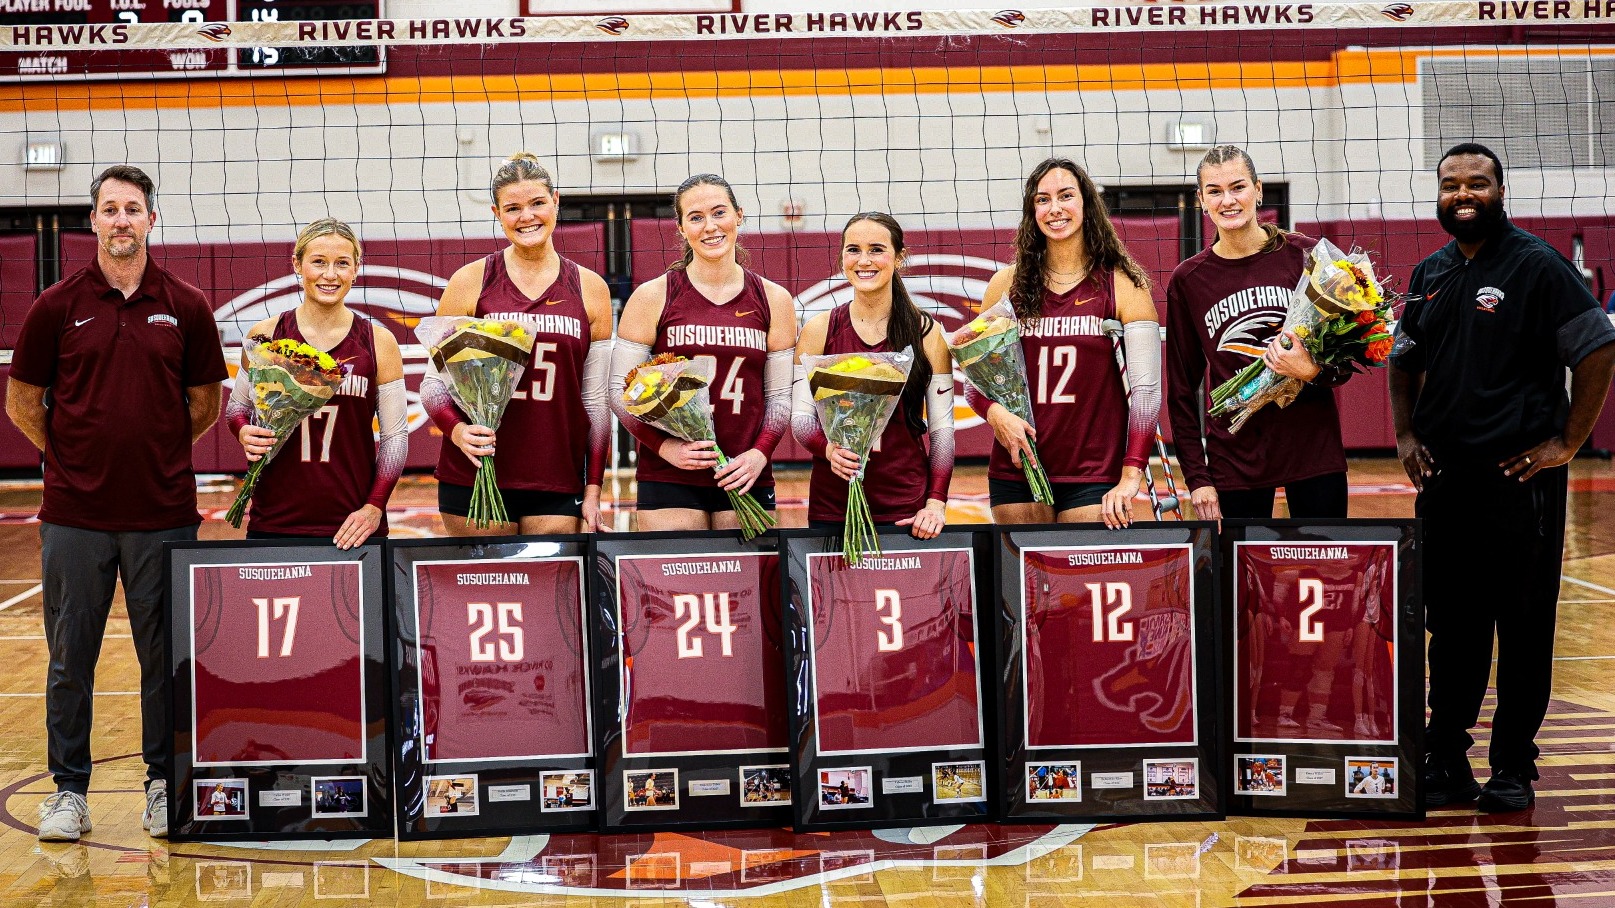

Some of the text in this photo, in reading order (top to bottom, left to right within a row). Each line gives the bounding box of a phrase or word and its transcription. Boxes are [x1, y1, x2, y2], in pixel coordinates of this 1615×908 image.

[1091, 4, 1314, 27] RIVER HAWKS
[1478, 0, 1571, 20] RIVER
[299, 18, 526, 41] RIVER HAWKS
[696, 11, 923, 35] RIVER HAWKS
[12, 25, 129, 45] HAWKS
[170, 53, 207, 70] WON
[1204, 286, 1295, 339] SUSQUEHANN
[1037, 345, 1077, 404] 12
[300, 405, 339, 463] 17
[1068, 552, 1143, 566] SUSQUEHANNA
[1270, 547, 1348, 560] SUSQUEHANNA
[239, 565, 312, 580] SUSQUEHANNA
[457, 573, 530, 585] SUSQUEHANNA
[661, 560, 741, 576] SUSQUEHANNA
[874, 588, 905, 652] 3
[1084, 582, 1133, 643] 12
[1298, 578, 1324, 642] 2
[251, 596, 301, 659] 17
[466, 601, 525, 663] 25
[672, 591, 739, 660] 24
